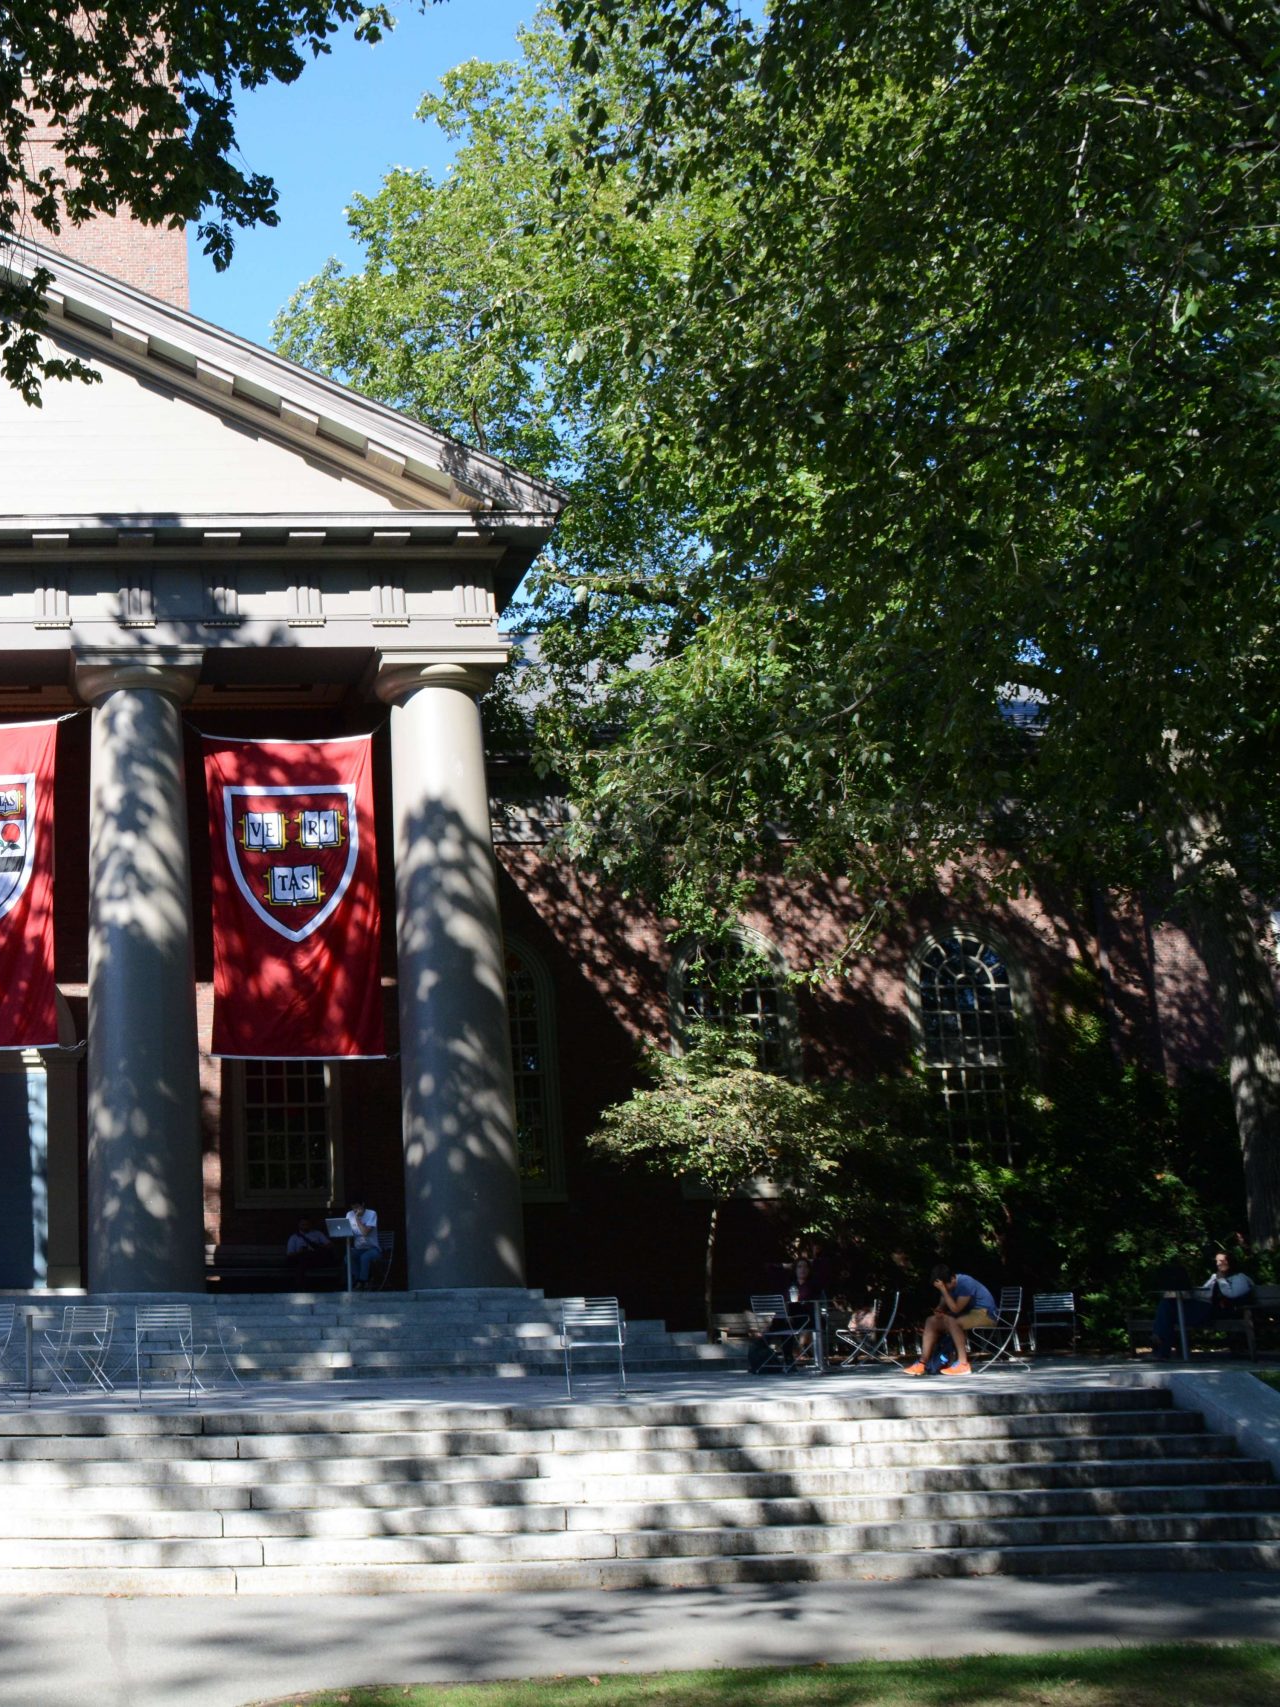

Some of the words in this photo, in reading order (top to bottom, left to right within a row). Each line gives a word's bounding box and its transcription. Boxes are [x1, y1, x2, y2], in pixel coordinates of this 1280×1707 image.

[250, 822, 275, 838] VE
[308, 820, 329, 835] RI
[277, 874, 311, 891] TAS
